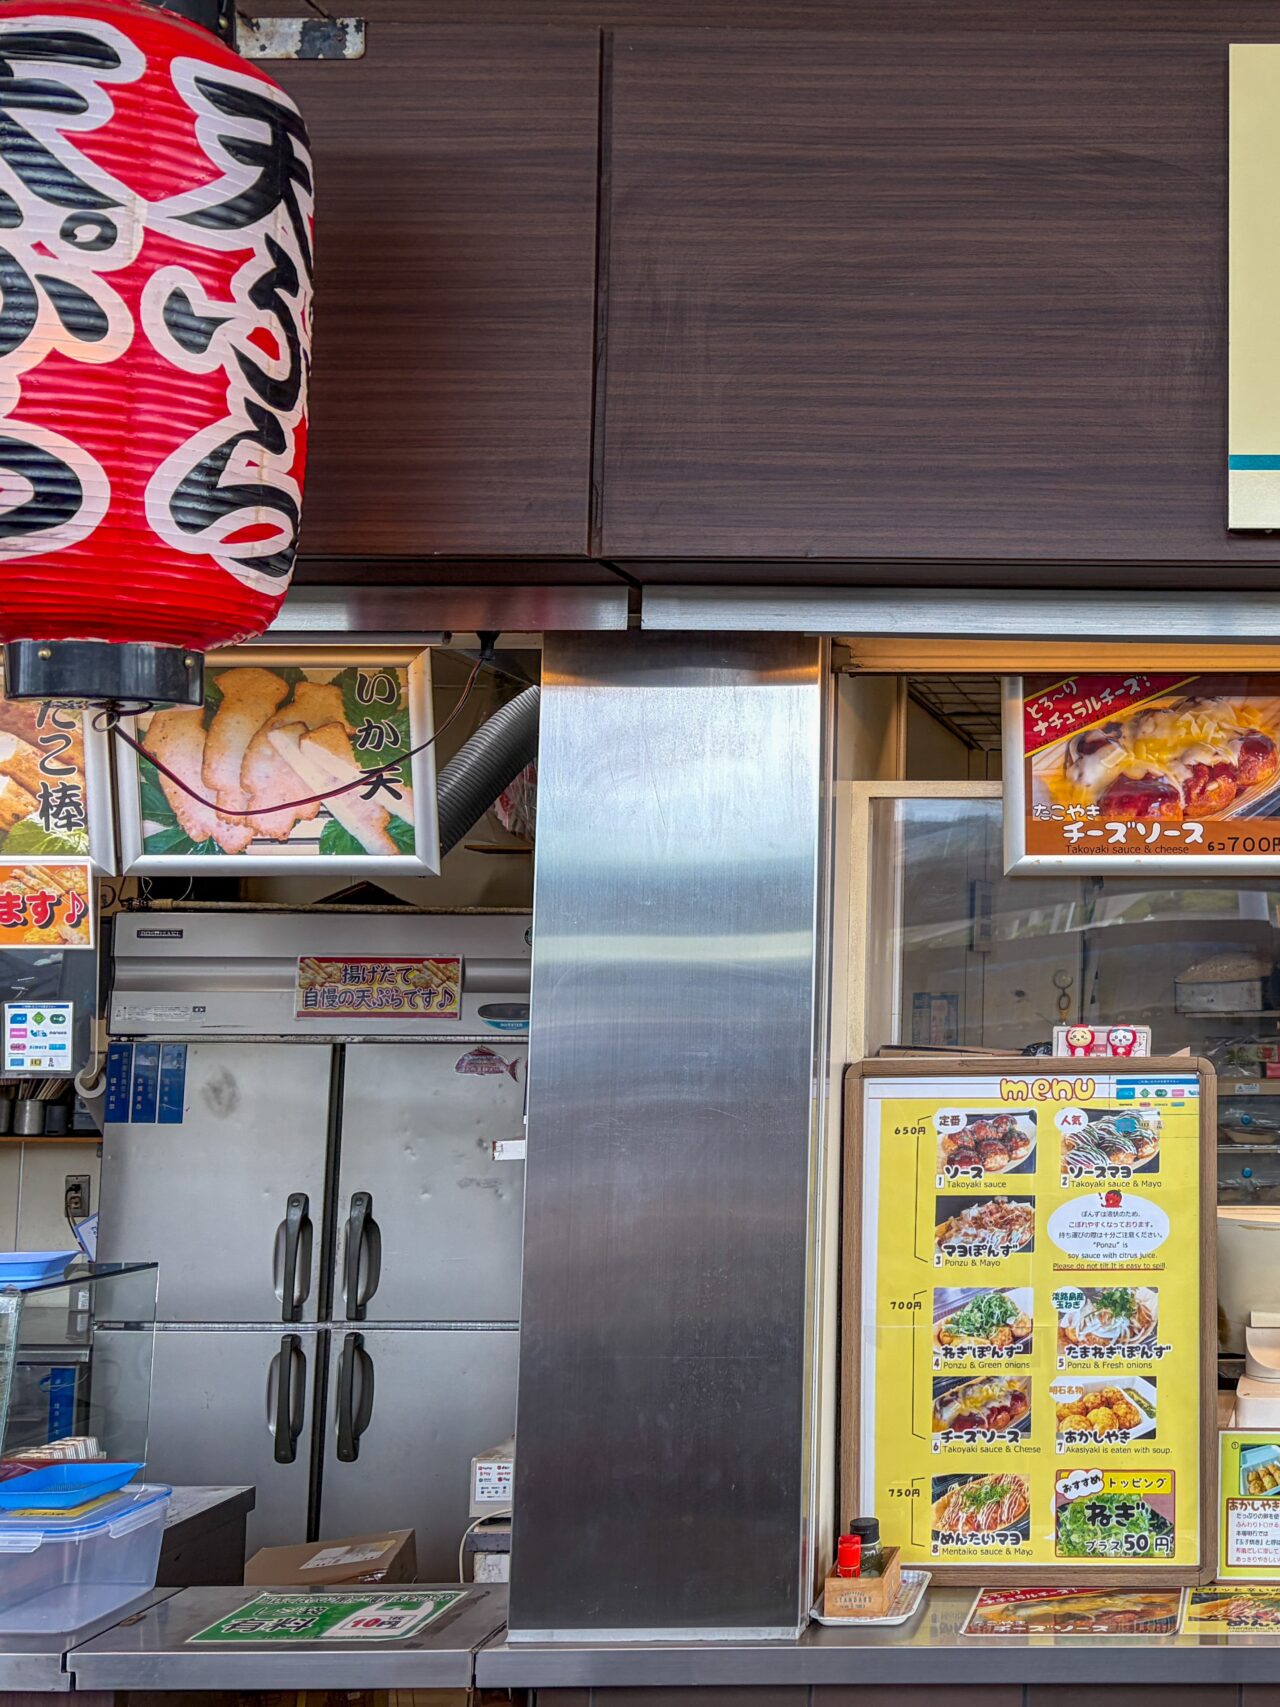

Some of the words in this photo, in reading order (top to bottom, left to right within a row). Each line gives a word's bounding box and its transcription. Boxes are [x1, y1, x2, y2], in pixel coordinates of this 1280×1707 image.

[355, 673, 404, 802] いか天
[1033, 804, 1100, 821] たこやき
[1063, 821, 1204, 845] チーズソース
[1066, 845, 1109, 855] Takoyaki
[1112, 846, 1141, 854] sauce
[1144, 845, 1151, 854] &
[1155, 845, 1189, 854] cheese
[342, 964, 414, 984] 揚げたて
[1000, 1077, 1096, 1101] menu
[939, 1115, 961, 1126] 定番
[1061, 1115, 1082, 1126] 人気
[894, 1126, 926, 1135] 650円
[945, 1166, 983, 1179] ソース
[1069, 1166, 1132, 1178] ソースマヨ
[947, 1181, 981, 1189] Takoyaki
[943, 1244, 1018, 1257] マヨぽんず
[980, 1260, 1000, 1268] Mayo
[890, 1302, 922, 1310] 700円
[1056, 1301, 1080, 1309] 玉ねぎ
[942, 1346, 1022, 1359] ねぎぽんず
[1066, 1346, 1171, 1359] たまねぎぽんず
[944, 1361, 967, 1369] Ponzu
[941, 1431, 1021, 1443] チーズソース
[1064, 1432, 1131, 1444] あかしやき
[933, 1443, 939, 1451] 6
[943, 1445, 978, 1454] Takoyaki
[1014, 1445, 1041, 1453] Cheese
[1057, 1443, 1063, 1451] 7
[1065, 1445, 1100, 1454] Akasiyaki
[1062, 1476, 1100, 1493] おすすめ
[1108, 1479, 1167, 1489] トッピング
[888, 1489, 920, 1497] 750円
[1085, 1502, 1145, 1528] ねぎ
[940, 1532, 1022, 1545] めんたいマヨ
[1015, 1548, 1033, 1556] Mayo
[222, 1617, 317, 1633] 有料
